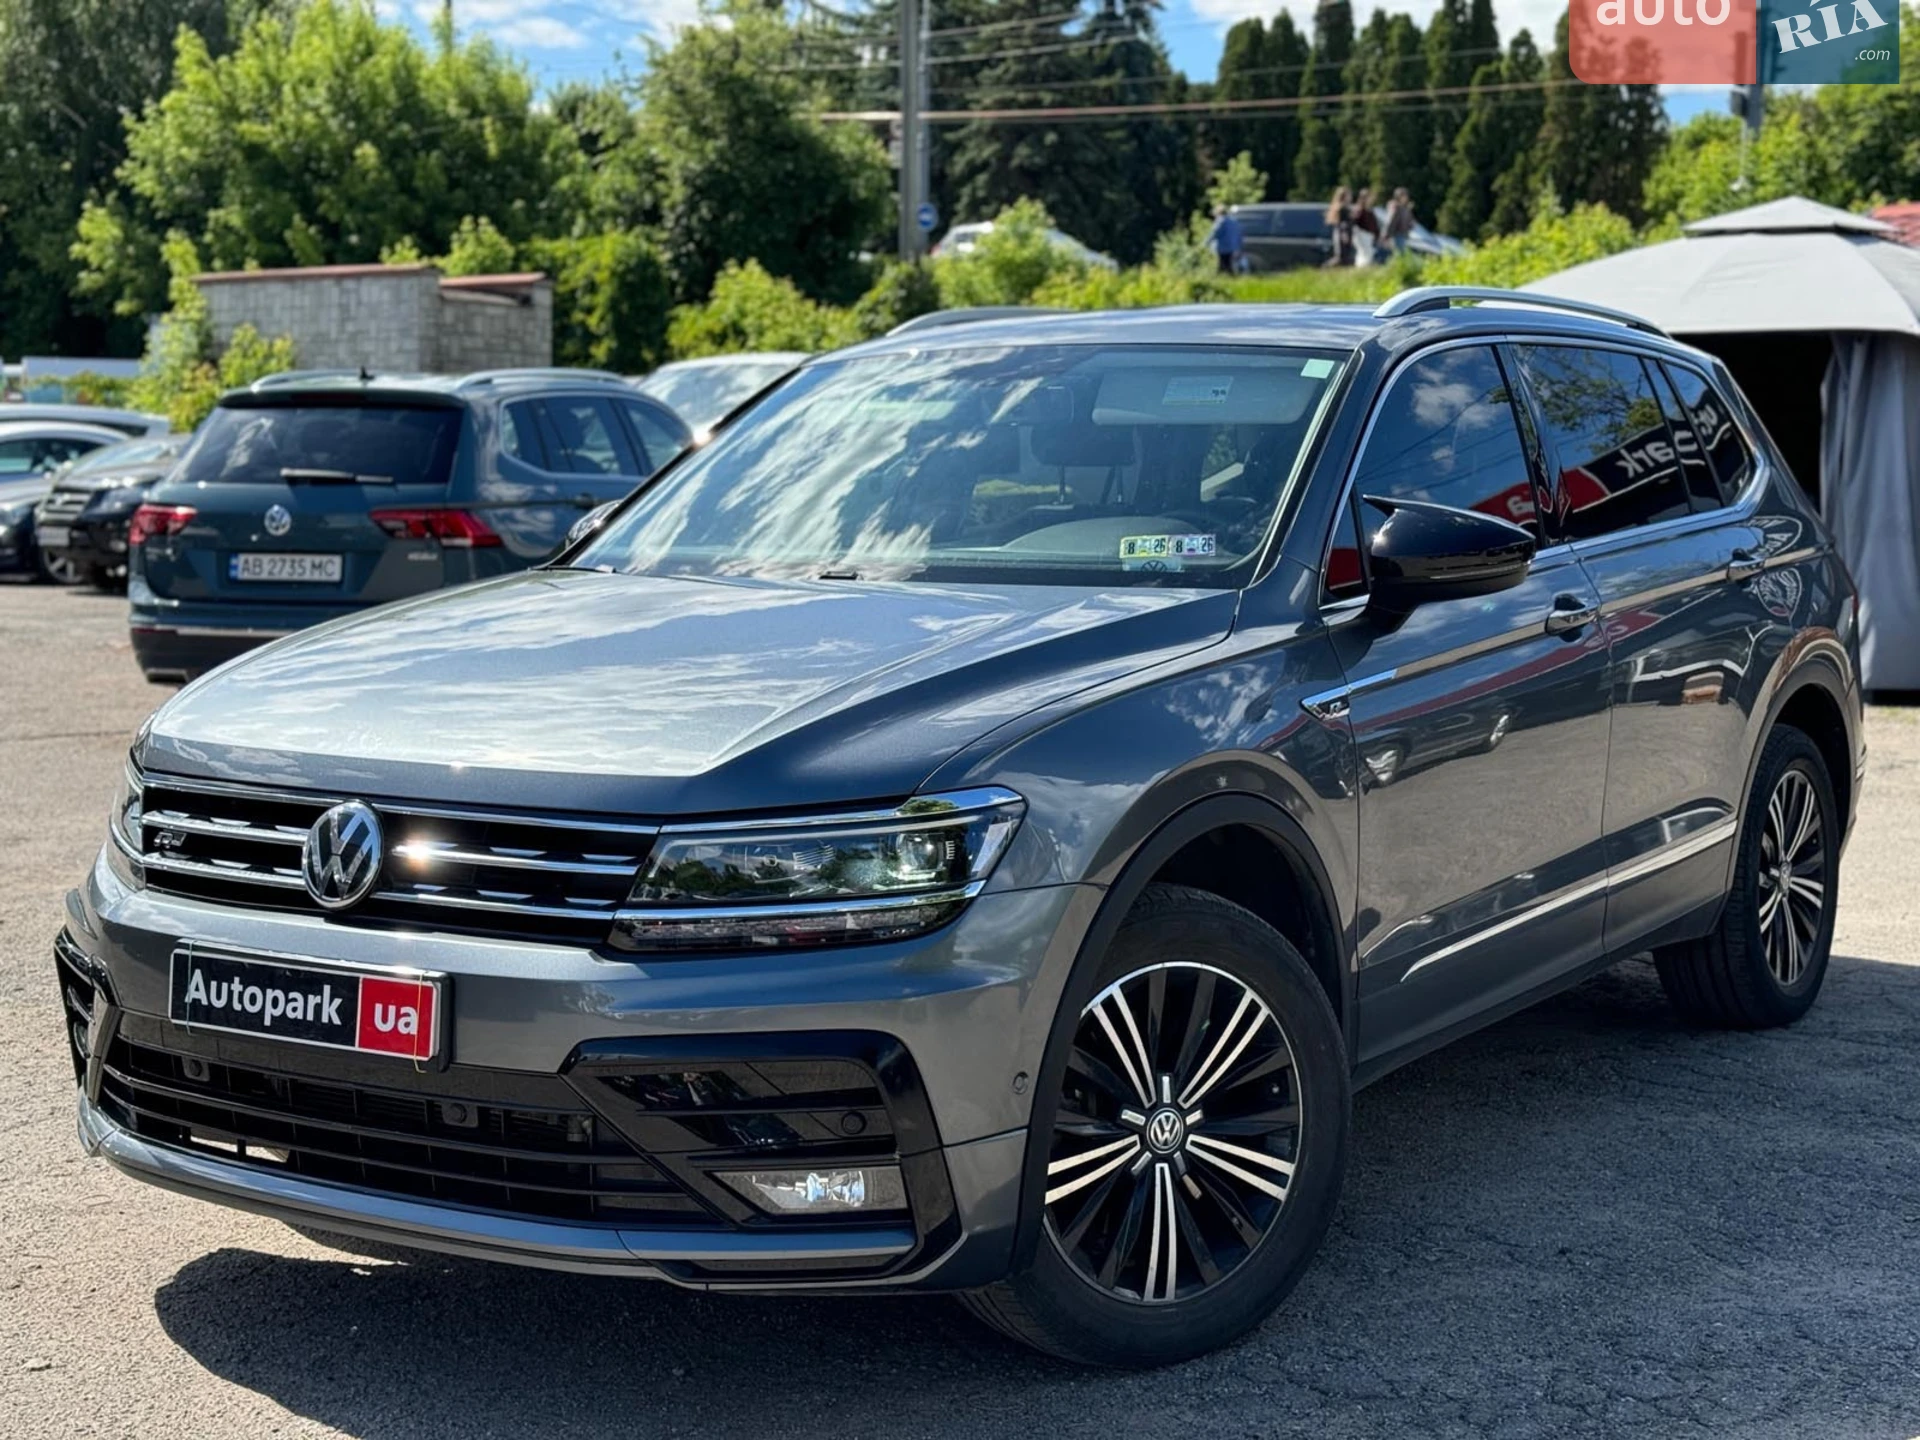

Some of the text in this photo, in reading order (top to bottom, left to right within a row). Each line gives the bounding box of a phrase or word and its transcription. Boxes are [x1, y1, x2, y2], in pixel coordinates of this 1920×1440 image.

[241, 558, 336, 577] AB 2735 MC
[302, 799, 384, 909] VW
[184, 968, 418, 1036] Autopark ua
